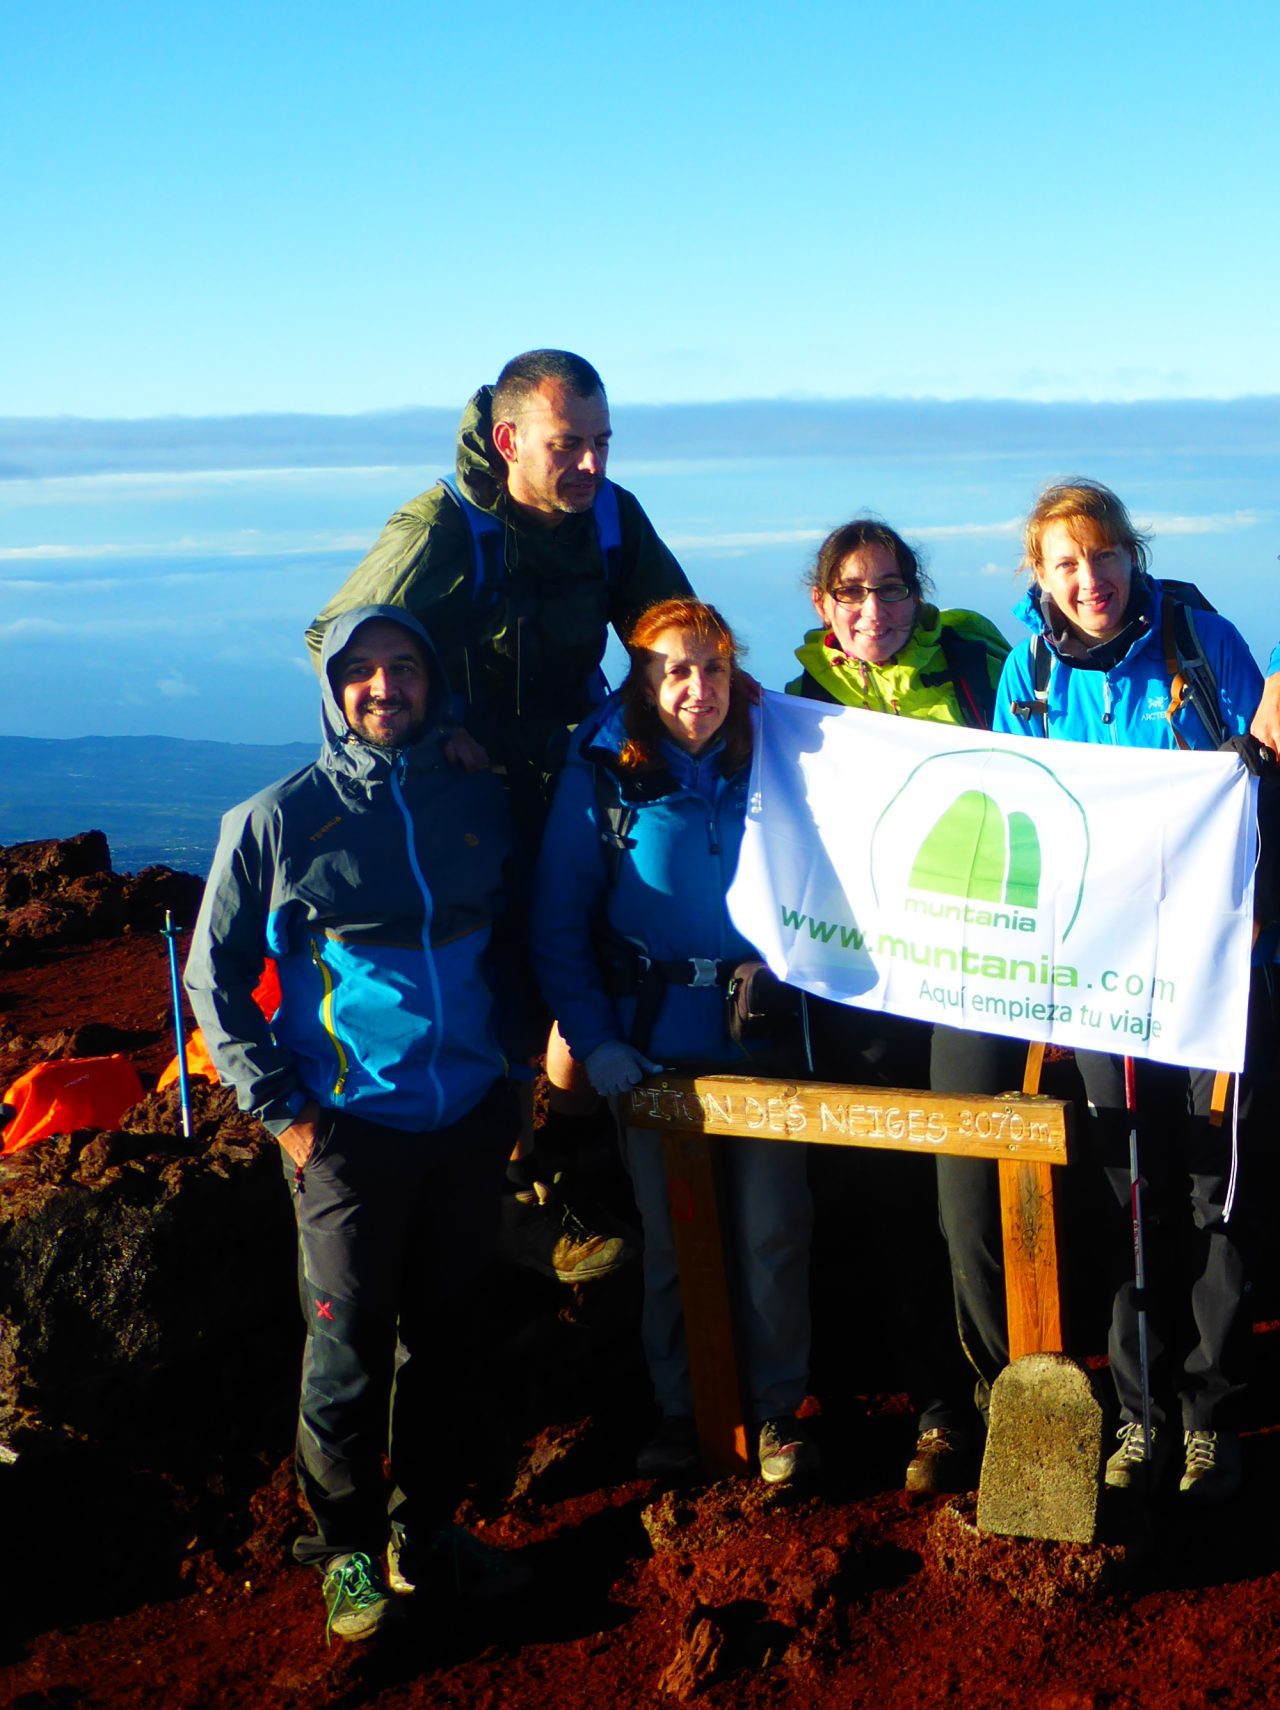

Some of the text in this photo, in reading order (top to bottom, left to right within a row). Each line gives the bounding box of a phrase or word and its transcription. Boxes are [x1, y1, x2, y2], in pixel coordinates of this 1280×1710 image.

[904, 896, 1036, 933] muntania
[780, 905, 1175, 1004] www.muntania.com
[919, 979, 1162, 1042] Aquí empieza tu viaje
[631, 1086, 1053, 1142] PITON DES NEIGES 3070m
